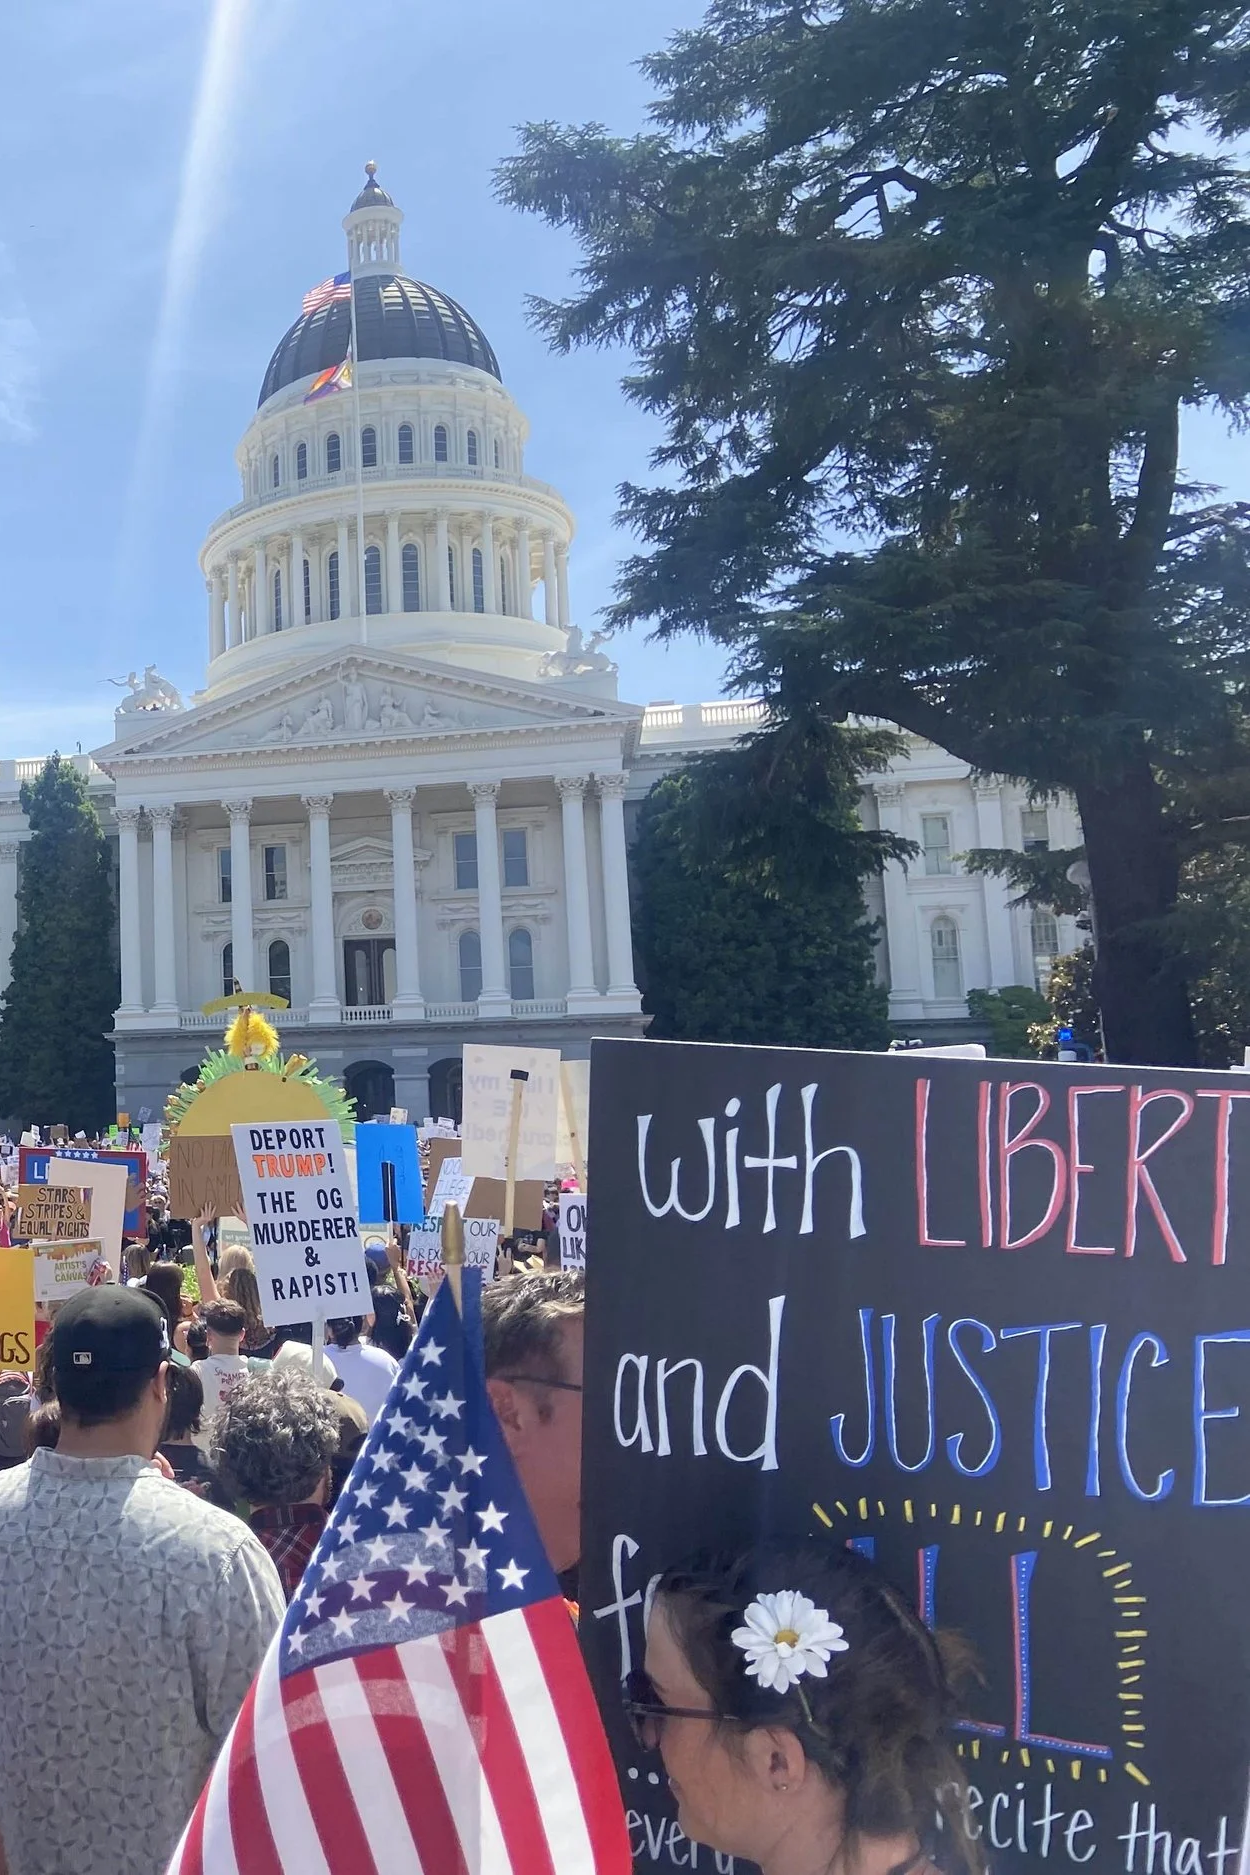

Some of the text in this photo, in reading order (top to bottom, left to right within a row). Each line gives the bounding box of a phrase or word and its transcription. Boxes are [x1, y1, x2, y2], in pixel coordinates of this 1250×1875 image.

[249, 1127, 325, 1151] DEPORT
[252, 1153, 335, 1178] TRUMP!
[637, 1083, 867, 1239] with
[26, 1204, 86, 1220] STRIPES &
[257, 1188, 343, 1214] THE OG
[20, 1221, 90, 1238] EQUAL RIGHTS
[253, 1216, 358, 1245] MURDERER
[470, 1221, 497, 1237] OUR
[54, 1260, 87, 1271] ARTIST'S
[304, 1246, 321, 1267] &
[468, 1250, 490, 1265] OUR
[54, 1271, 88, 1283] CANVAS
[271, 1271, 359, 1300] RAPIST!
[614, 1295, 1250, 1508] and JUSTICE
[847, 1536, 1113, 1760] LL
[1116, 1800, 1242, 1875] that
